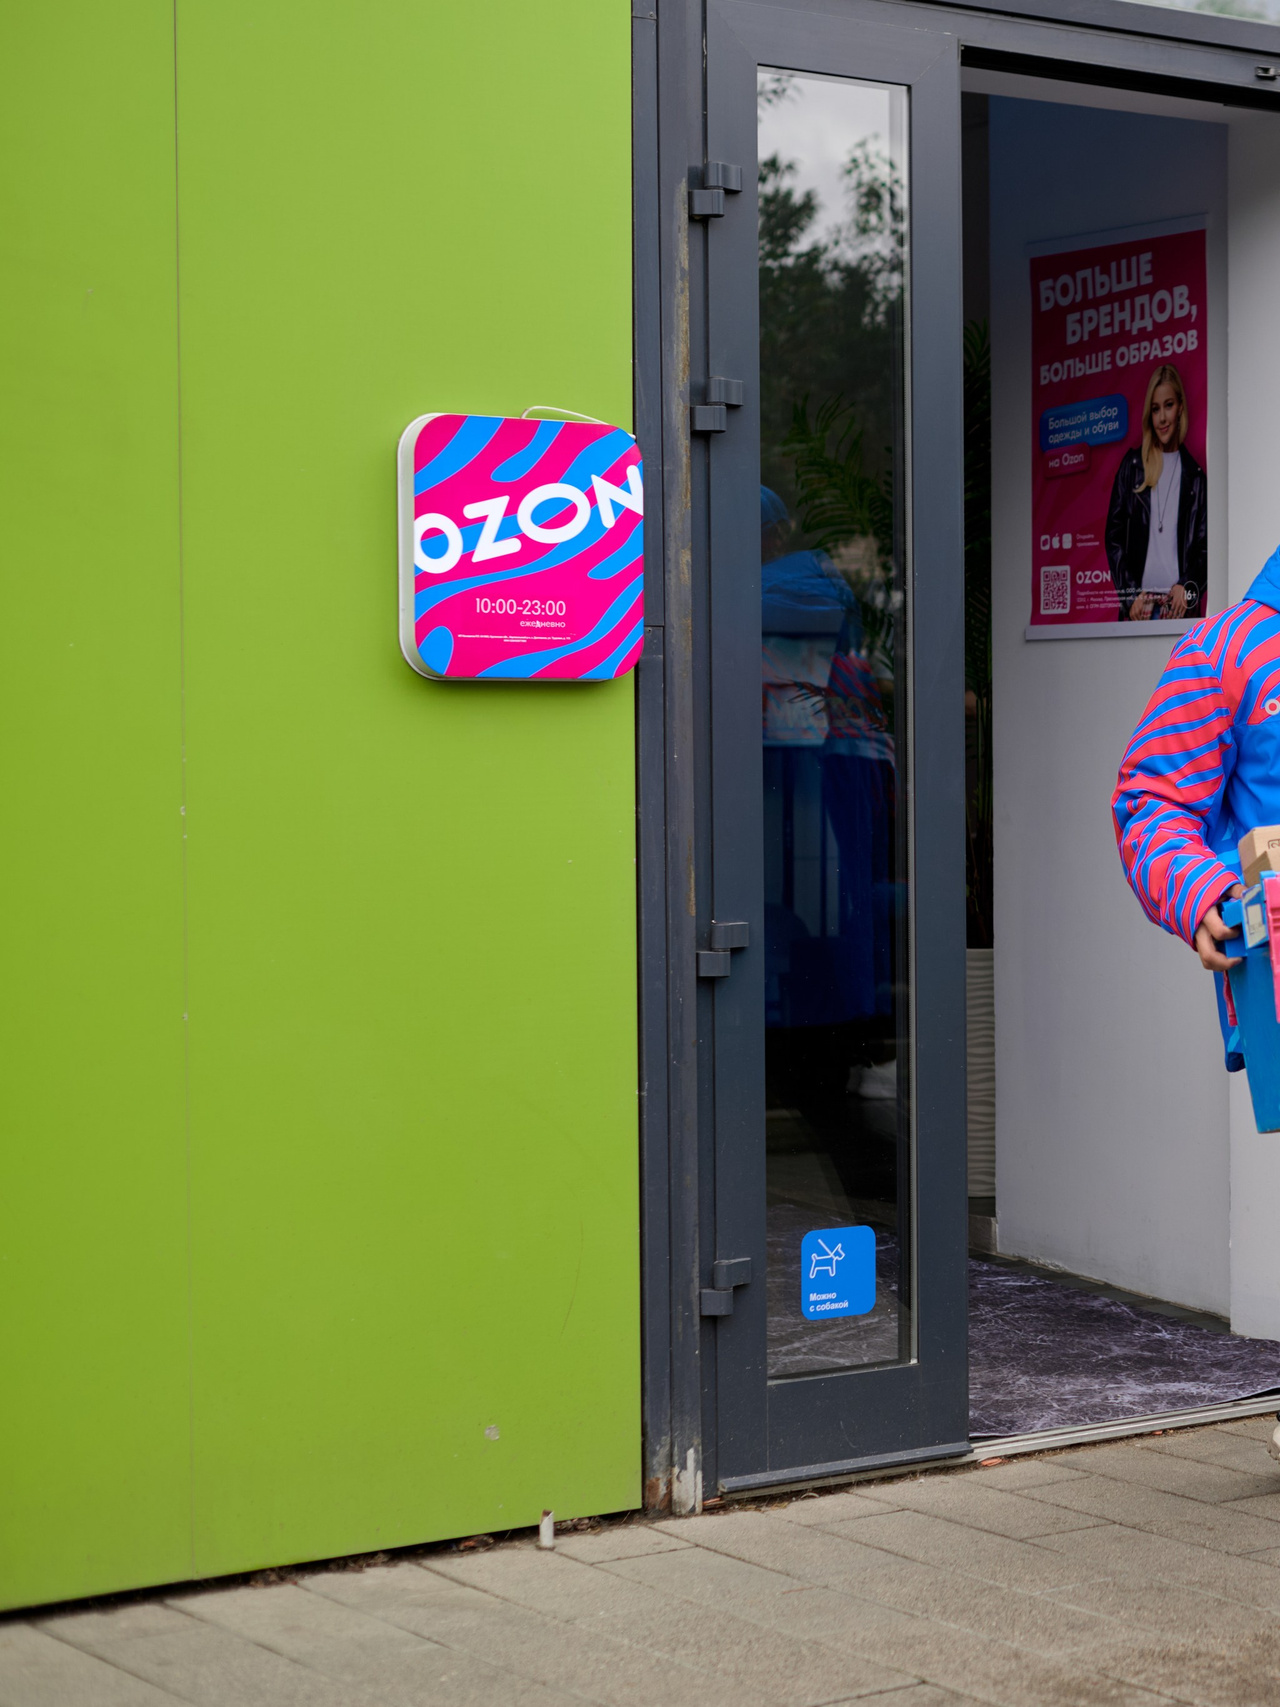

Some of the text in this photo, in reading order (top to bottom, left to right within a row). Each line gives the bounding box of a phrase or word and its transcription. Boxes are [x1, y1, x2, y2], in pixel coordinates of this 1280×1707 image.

[1039, 252, 1153, 312] БОЛЬШЕ
[1066, 285, 1197, 345] БРЕНДОВ,
[1039, 329, 1198, 386] БОЛЬШЕ ОБРАЗОВ
[1048, 406, 1118, 430] Большой выбор
[1048, 421, 1119, 444] одежды и обуви
[1048, 453, 1084, 469] на Ozon
[414, 464, 643, 574] OZON
[1076, 570, 1111, 585] OZON
[1184, 589, 1197, 600] 16+
[475, 597, 566, 616] 10:00-23:00
[520, 620, 566, 630] ежедневно
[809, 1292, 837, 1301] Можно
[816, 1300, 849, 1311] собакой
